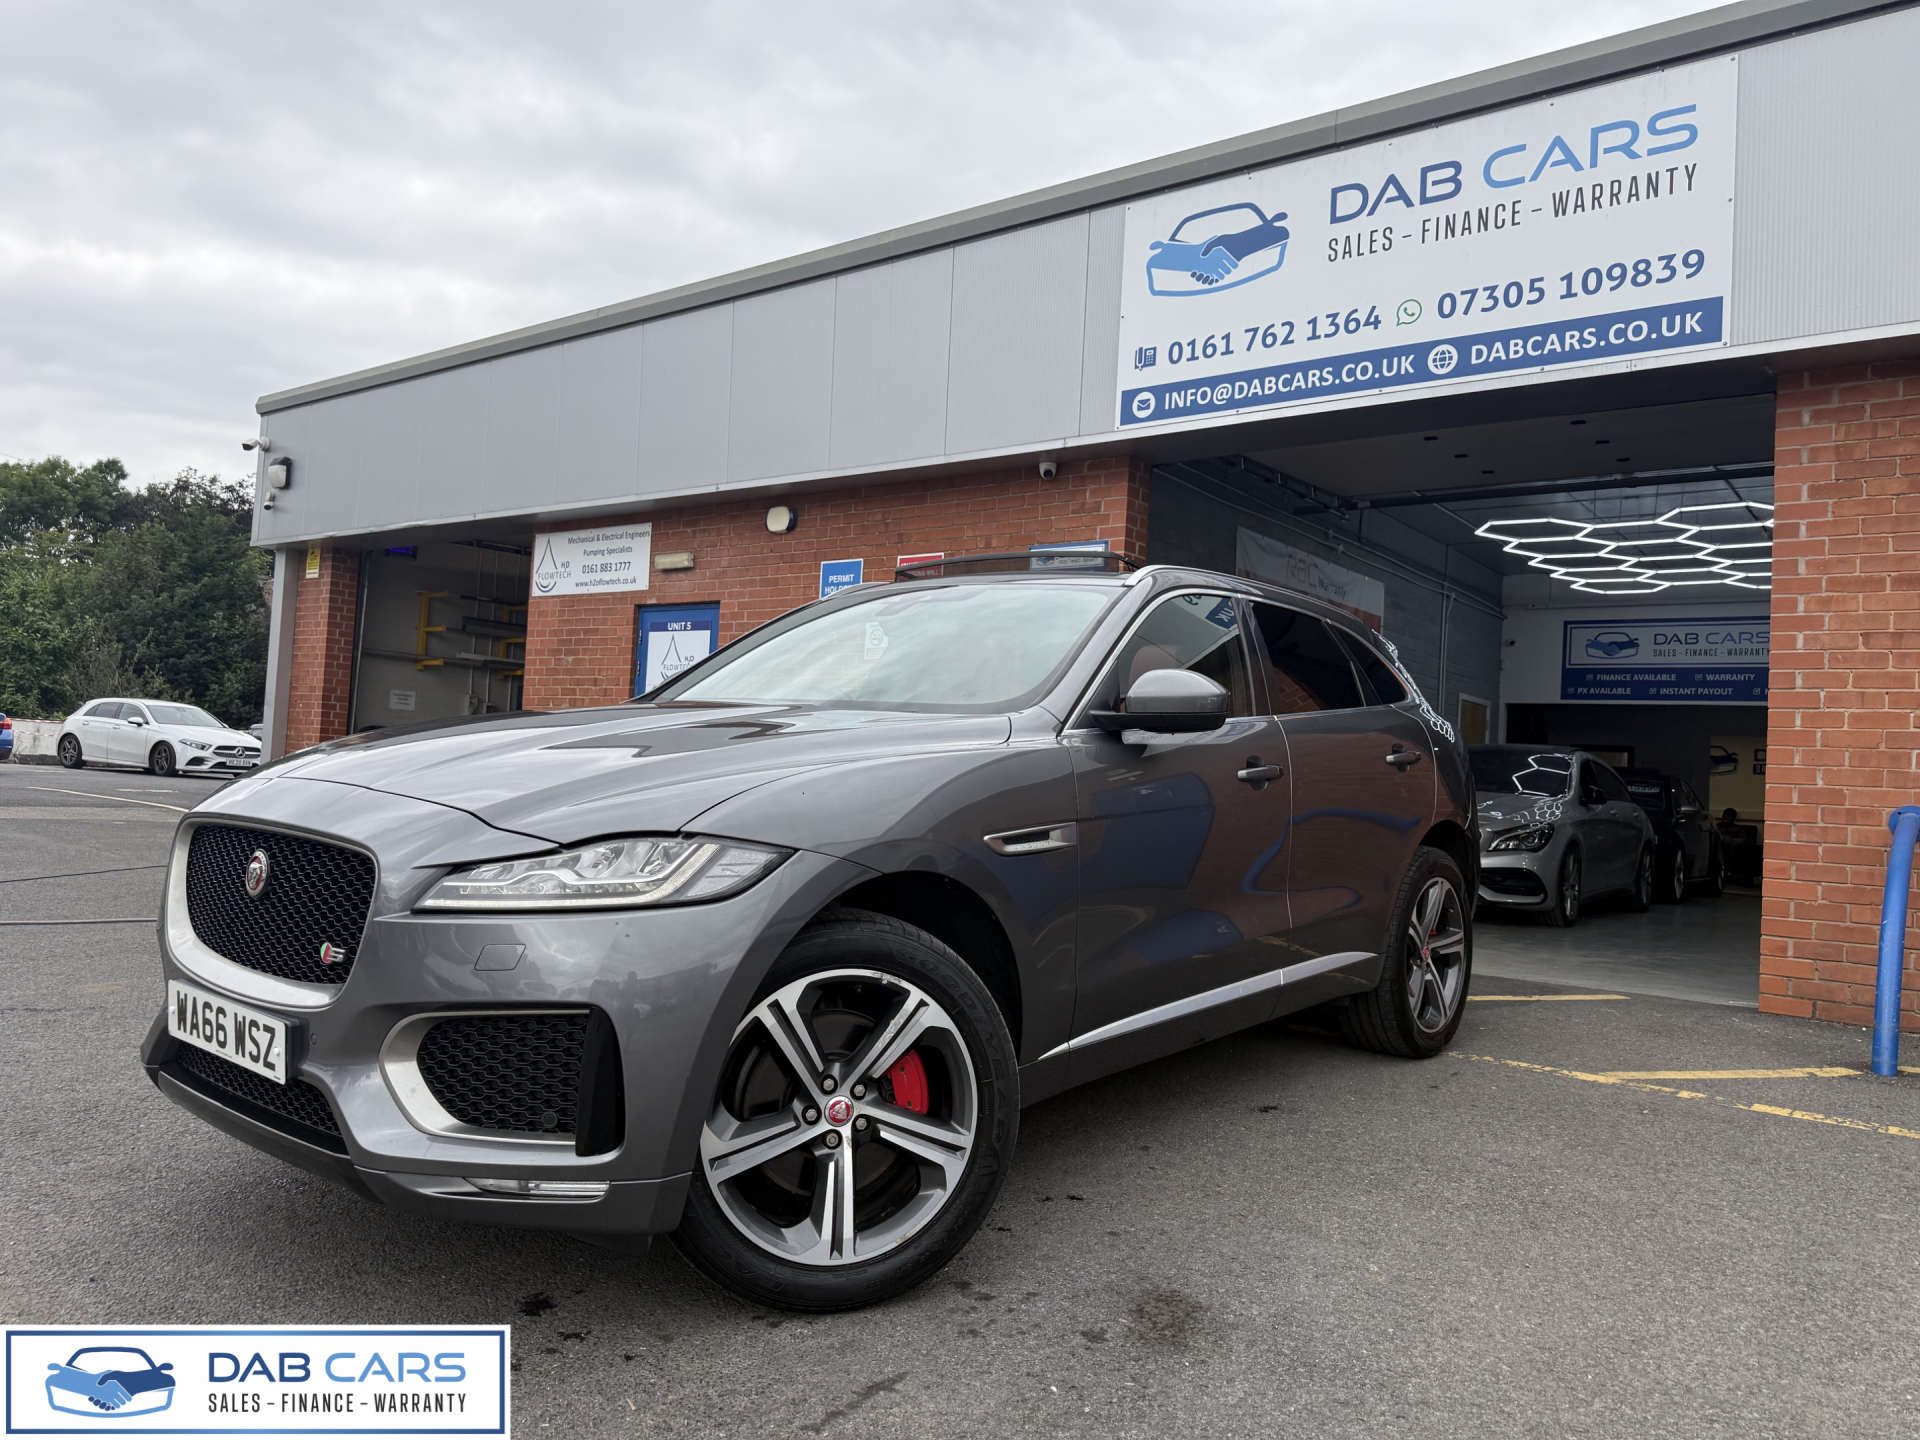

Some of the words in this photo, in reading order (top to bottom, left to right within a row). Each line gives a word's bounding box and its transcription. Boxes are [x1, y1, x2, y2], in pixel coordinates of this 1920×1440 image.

[1330, 160, 1463, 225] DAB
[1482, 103, 1698, 189] CARS
[1328, 226, 1393, 262] SALES
[1421, 200, 1522, 244] FINANCE
[1552, 162, 1697, 218] WARRANTY
[1167, 332, 1234, 365] 0161
[1244, 320, 1295, 352] 762
[1306, 305, 1382, 341] 1364
[1437, 276, 1546, 319] 07305
[1560, 248, 1705, 300] 109839
[1164, 353, 1415, 410] INFO@DABCARS.CO.UK
[1470, 311, 1703, 365] DABCARS.CO.UK
[568, 535, 595, 544] Mechanical
[602, 532, 624, 542] Electrical
[625, 530, 650, 541] Engineers
[583, 548, 606, 557] Pumping
[606, 546, 633, 554] Specialists
[582, 564, 598, 574] 0161
[600, 562, 613, 572] 883
[614, 562, 632, 572] 1777
[538, 570, 572, 581] FLOWTECH
[828, 574, 855, 584] PERMIT
[667, 622, 686, 630] UNIT
[686, 622, 692, 630] 5
[1654, 632, 1700, 646] DAB
[1706, 631, 1770, 645] CARS
[1653, 648, 1677, 658] SALES
[1685, 648, 1718, 657] FINANCE
[177, 990, 228, 1049] WA66
[234, 1012, 276, 1072] WSZ
